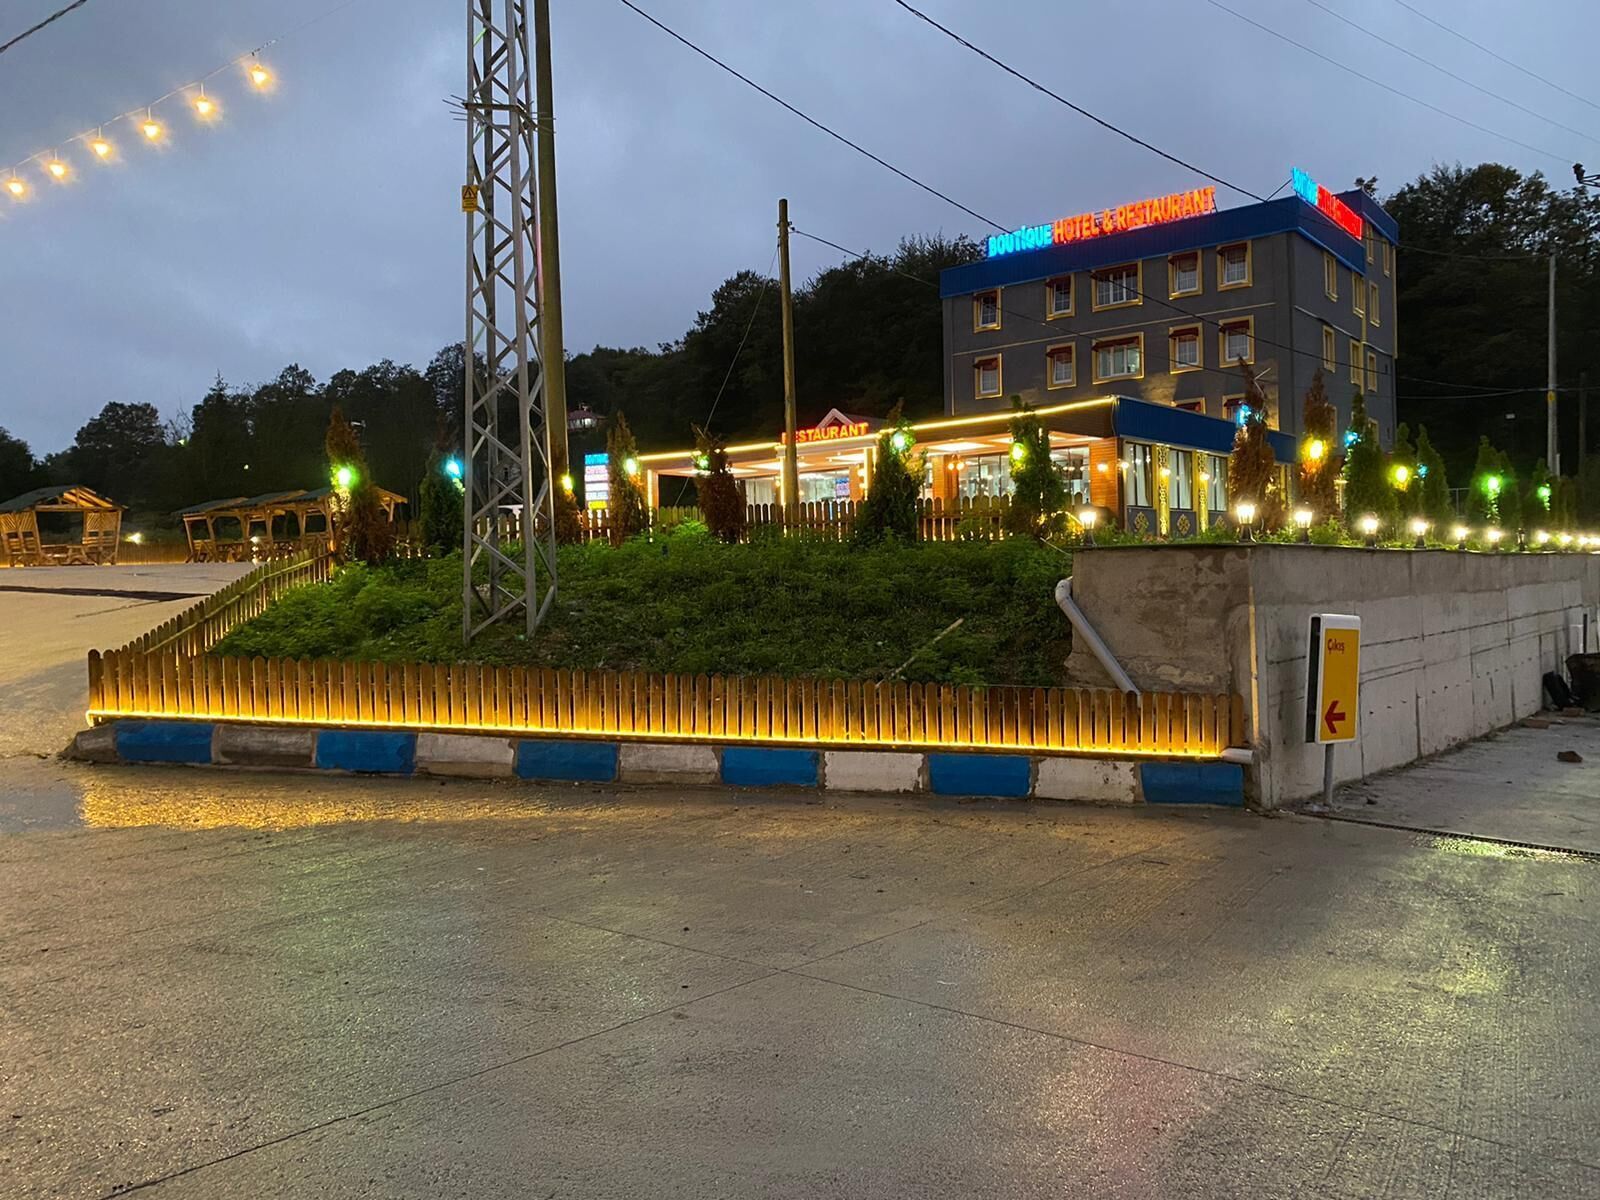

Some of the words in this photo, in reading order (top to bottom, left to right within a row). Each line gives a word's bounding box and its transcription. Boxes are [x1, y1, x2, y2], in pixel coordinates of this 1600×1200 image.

[1053, 212, 1101, 244] HOTEL
[1102, 208, 1114, 234] &
[1115, 186, 1216, 230] RESTAURANT
[781, 422, 868, 444] STAURANT
